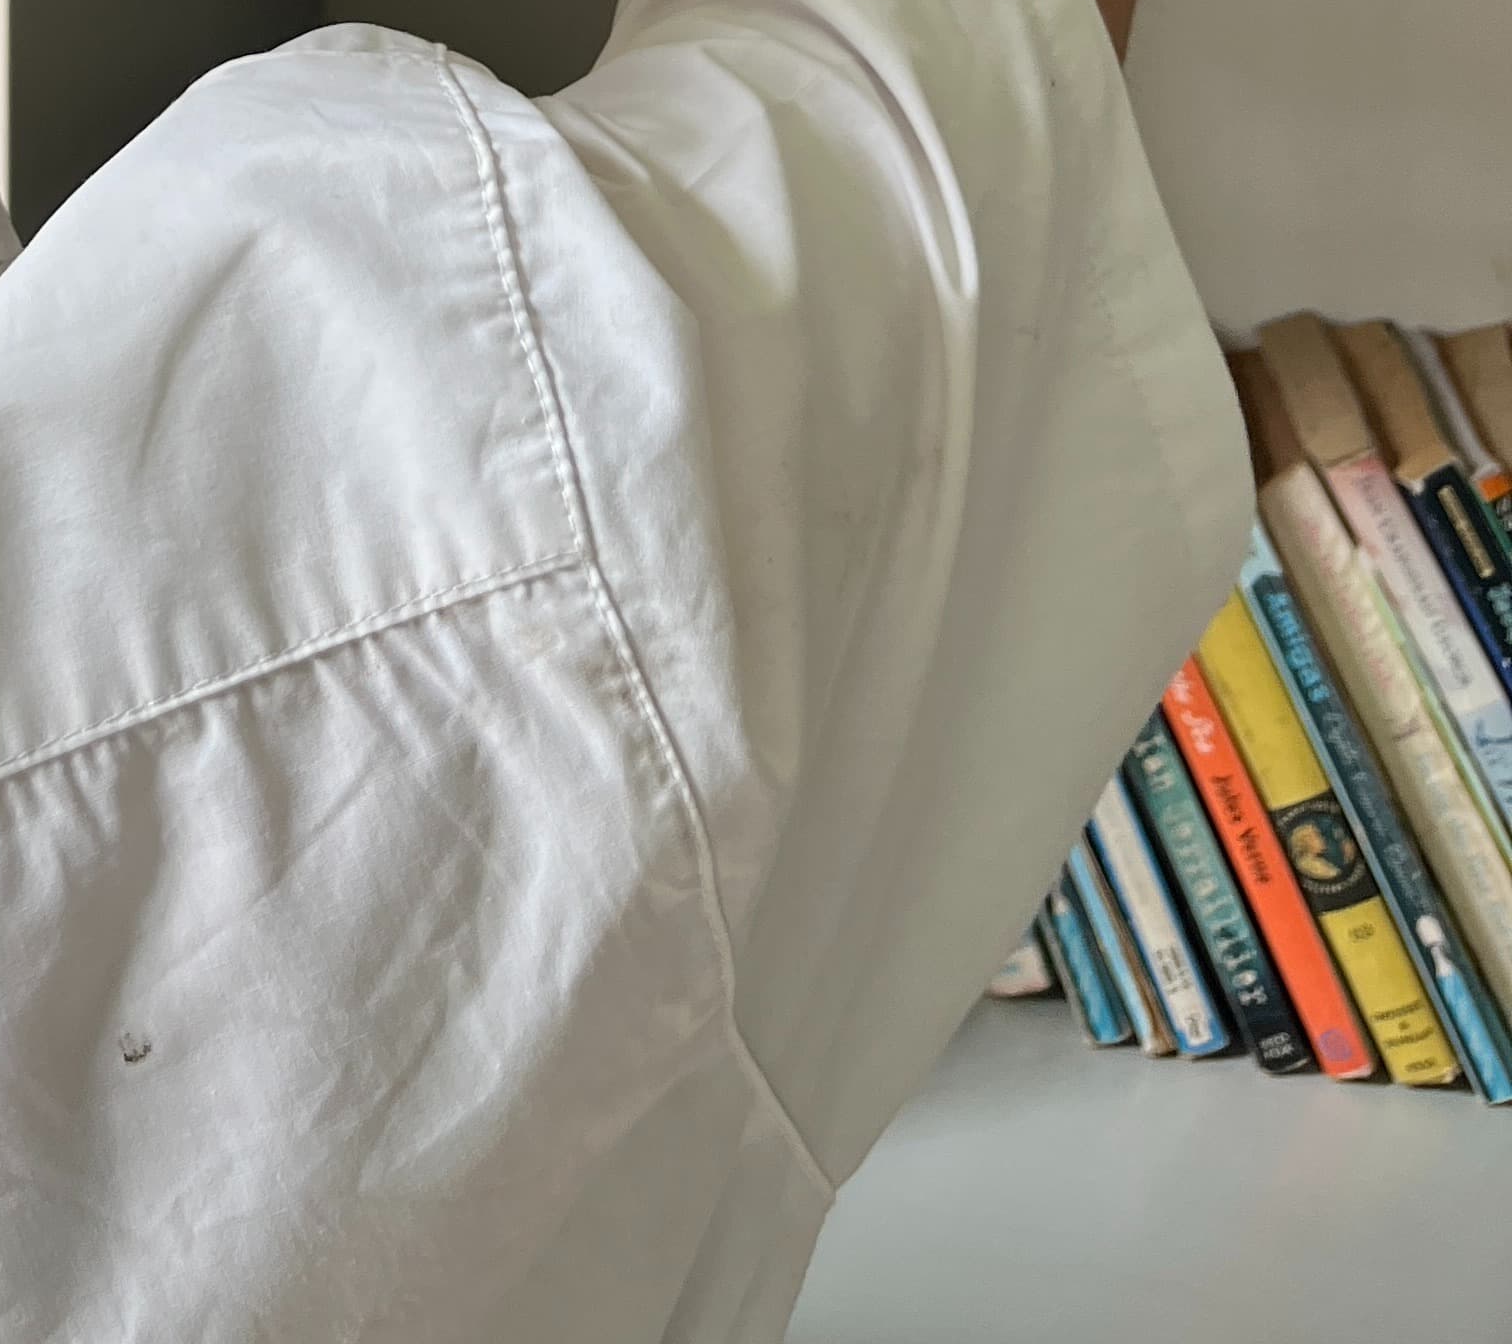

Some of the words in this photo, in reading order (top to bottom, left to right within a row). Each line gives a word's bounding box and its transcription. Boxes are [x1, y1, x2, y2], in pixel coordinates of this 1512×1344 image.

[1266, 590, 1330, 703] Amigas
[1212, 775, 1242, 823] Jules
[1236, 828, 1273, 885] Verne
